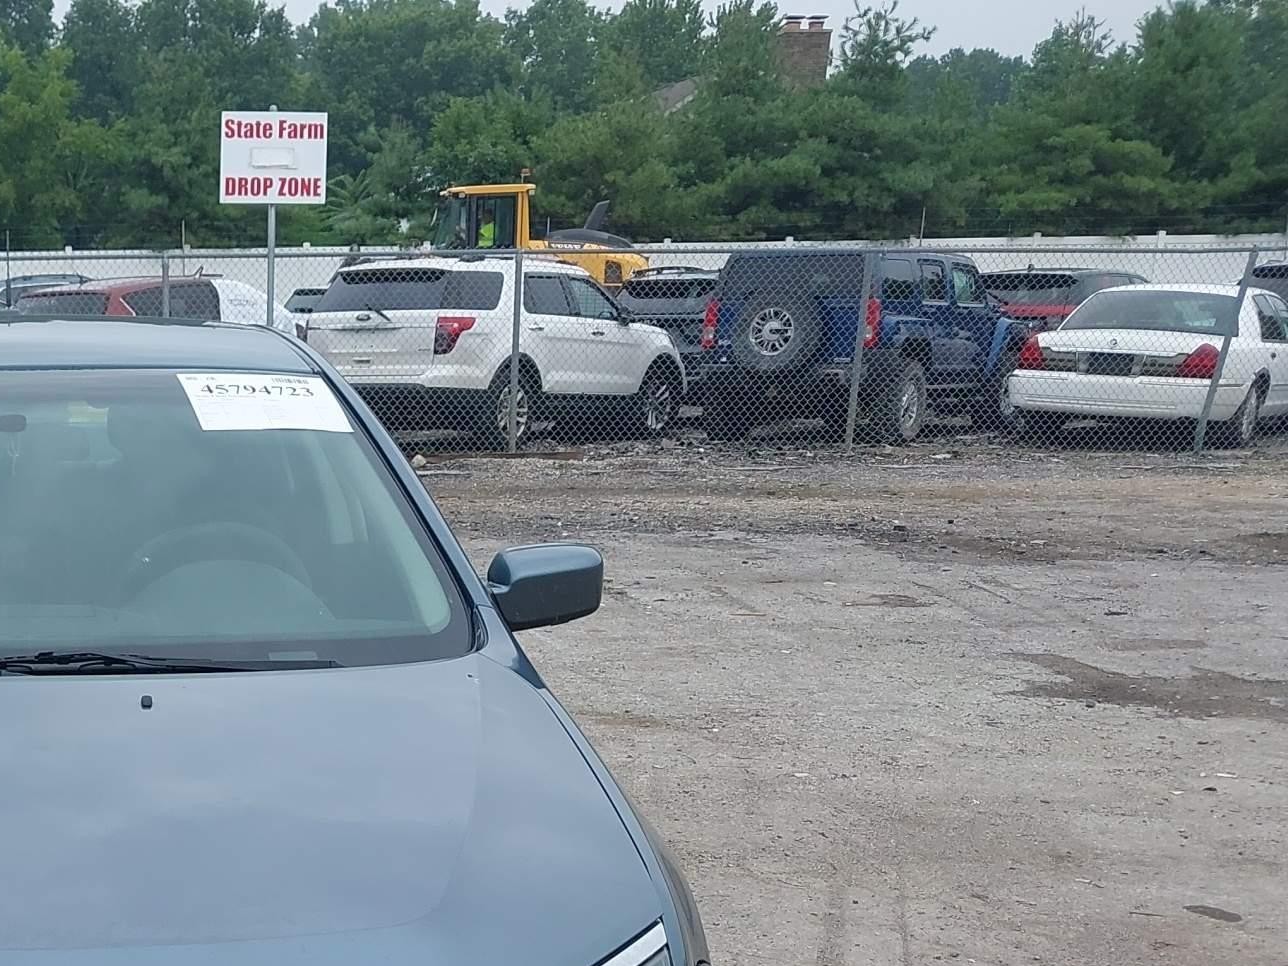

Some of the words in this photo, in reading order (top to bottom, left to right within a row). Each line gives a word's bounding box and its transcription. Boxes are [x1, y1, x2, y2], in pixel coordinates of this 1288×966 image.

[225, 119, 272, 138] State
[278, 120, 324, 139] Farm
[225, 177, 273, 196] DROP
[278, 178, 321, 197] ZONE
[200, 384, 314, 397] 45794723
